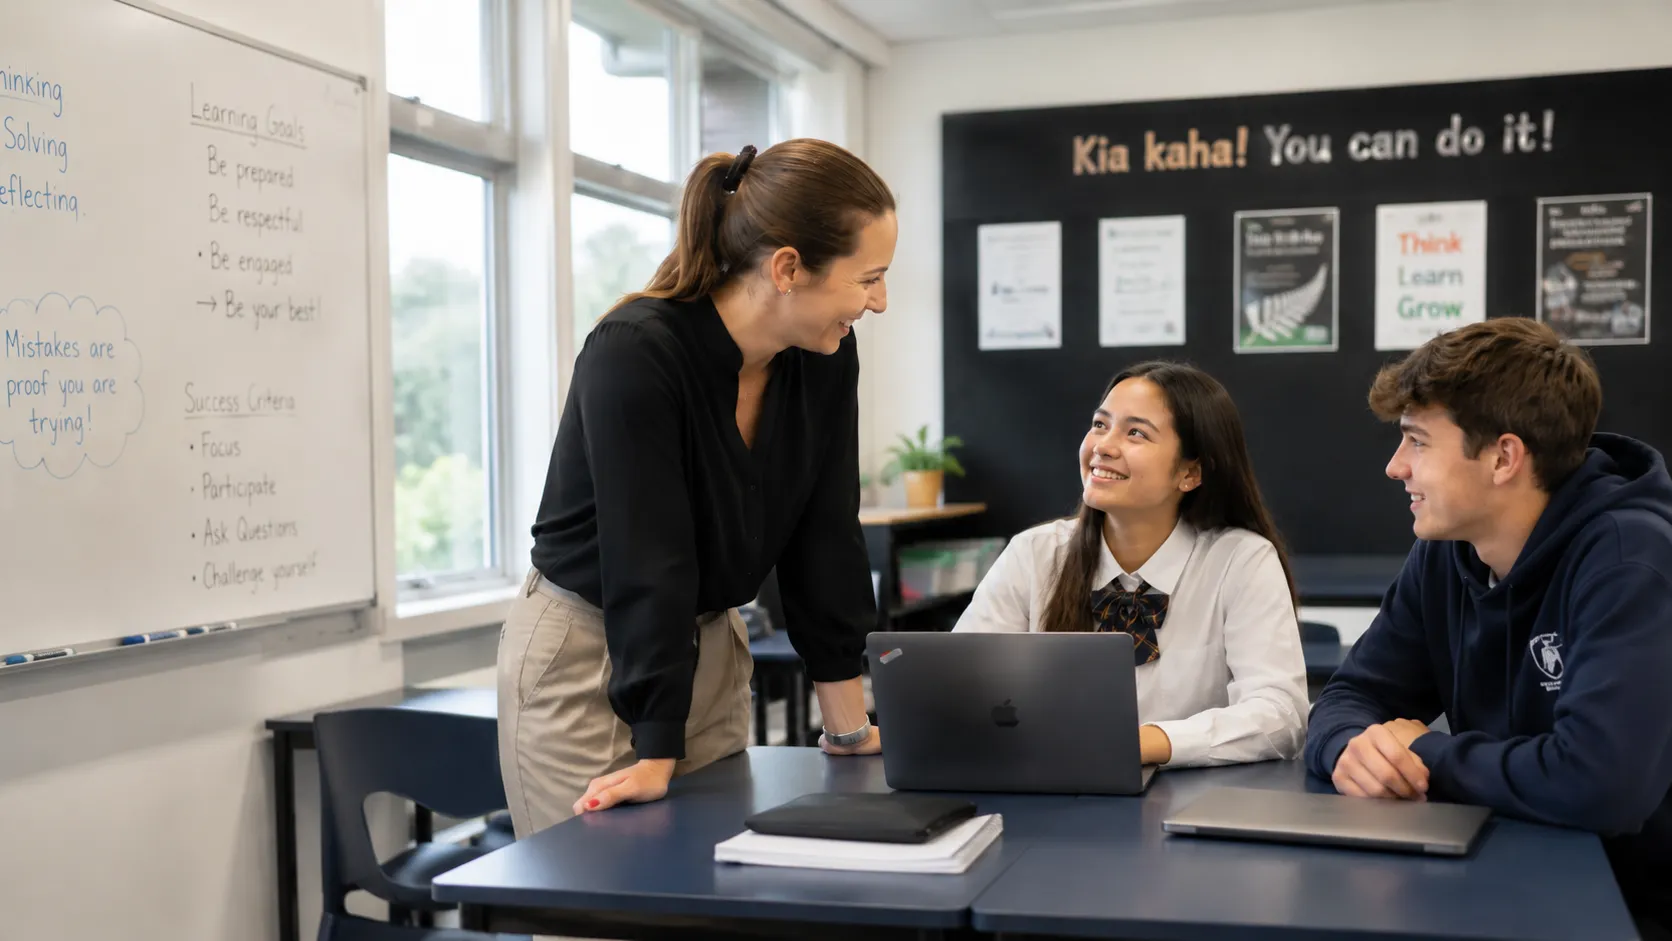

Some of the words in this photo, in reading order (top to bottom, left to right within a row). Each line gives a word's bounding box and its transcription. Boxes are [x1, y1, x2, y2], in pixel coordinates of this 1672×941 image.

[189, 81, 258, 147] Learning
[265, 103, 305, 143] Goals
[4, 115, 68, 174] Solving
[1072, 135, 1130, 175] Kia
[1143, 125, 1249, 172] kaha!
[1263, 123, 1332, 167] You
[1348, 128, 1418, 162] can
[1435, 112, 1485, 157] do
[1502, 107, 1555, 154] it!
[207, 144, 228, 177] Be
[236, 162, 294, 193] prepared
[208, 192, 230, 223] Be
[236, 206, 303, 238] respectful
[210, 239, 231, 270] Be
[238, 255, 293, 286] engaged
[1396, 230, 1464, 256] Think
[1397, 264, 1464, 288] Learn
[224, 288, 246, 319] Be
[251, 302, 281, 331] your
[1397, 294, 1464, 319] Grow
[5, 328, 80, 358] Mistakes
[89, 342, 116, 359] are
[6, 368, 50, 408] proof
[58, 379, 84, 408] you
[92, 379, 117, 395] are
[184, 381, 240, 414] Success
[28, 403, 92, 446] trying!
[201, 430, 242, 458] Focus
[202, 472, 277, 507] Participate
[203, 517, 230, 547] Ask
[236, 515, 299, 542] Questions
[203, 560, 265, 595] Challenge
[271, 550, 318, 591] yourself
